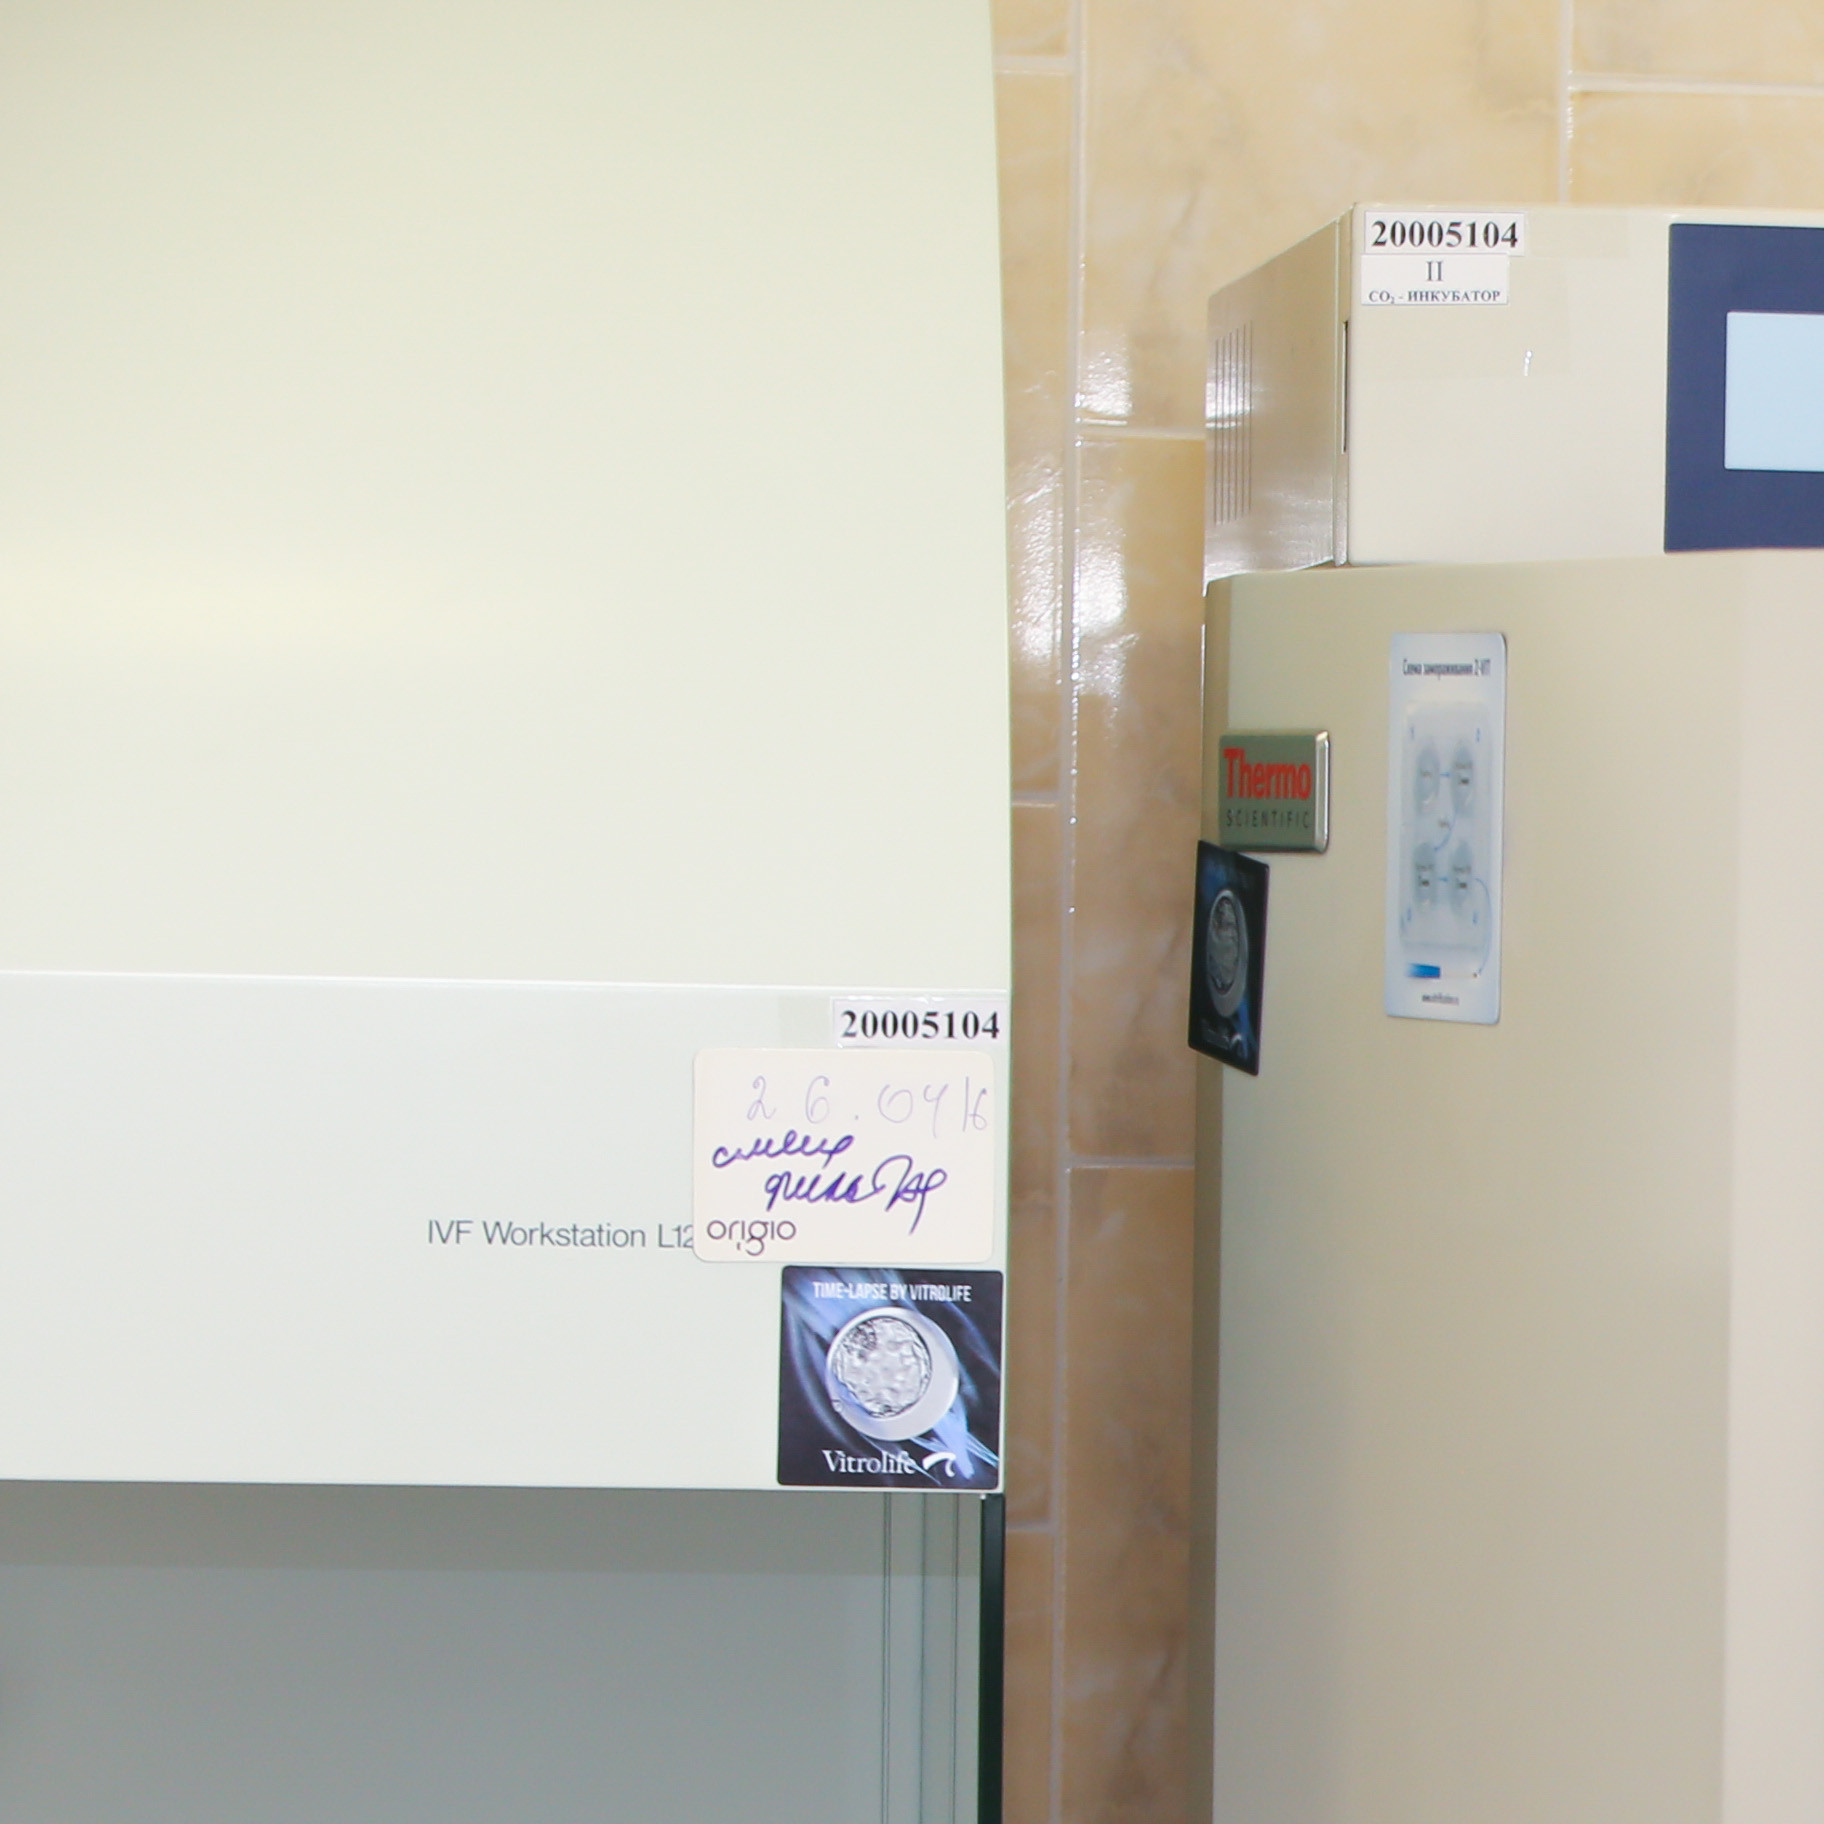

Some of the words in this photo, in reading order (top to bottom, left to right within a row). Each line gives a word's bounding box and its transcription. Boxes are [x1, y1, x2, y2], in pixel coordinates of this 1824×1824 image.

[1372, 220, 1518, 248] 20005104
[1408, 290, 1500, 302] ИНКУБАТОР
[1223, 747, 1313, 799] Thermo
[1226, 809, 1310, 829] SCIENTIFIC
[841, 1010, 999, 1039] 20005104
[428, 1219, 474, 1244] IVF
[481, 1220, 646, 1248] Workstation
[706, 1219, 797, 1256] origio
[813, 1282, 888, 1299] TIME-LAPSE
[890, 1284, 907, 1299] BY
[910, 1284, 972, 1302] VITROLIFE
[822, 1449, 916, 1474] Vitrolife
